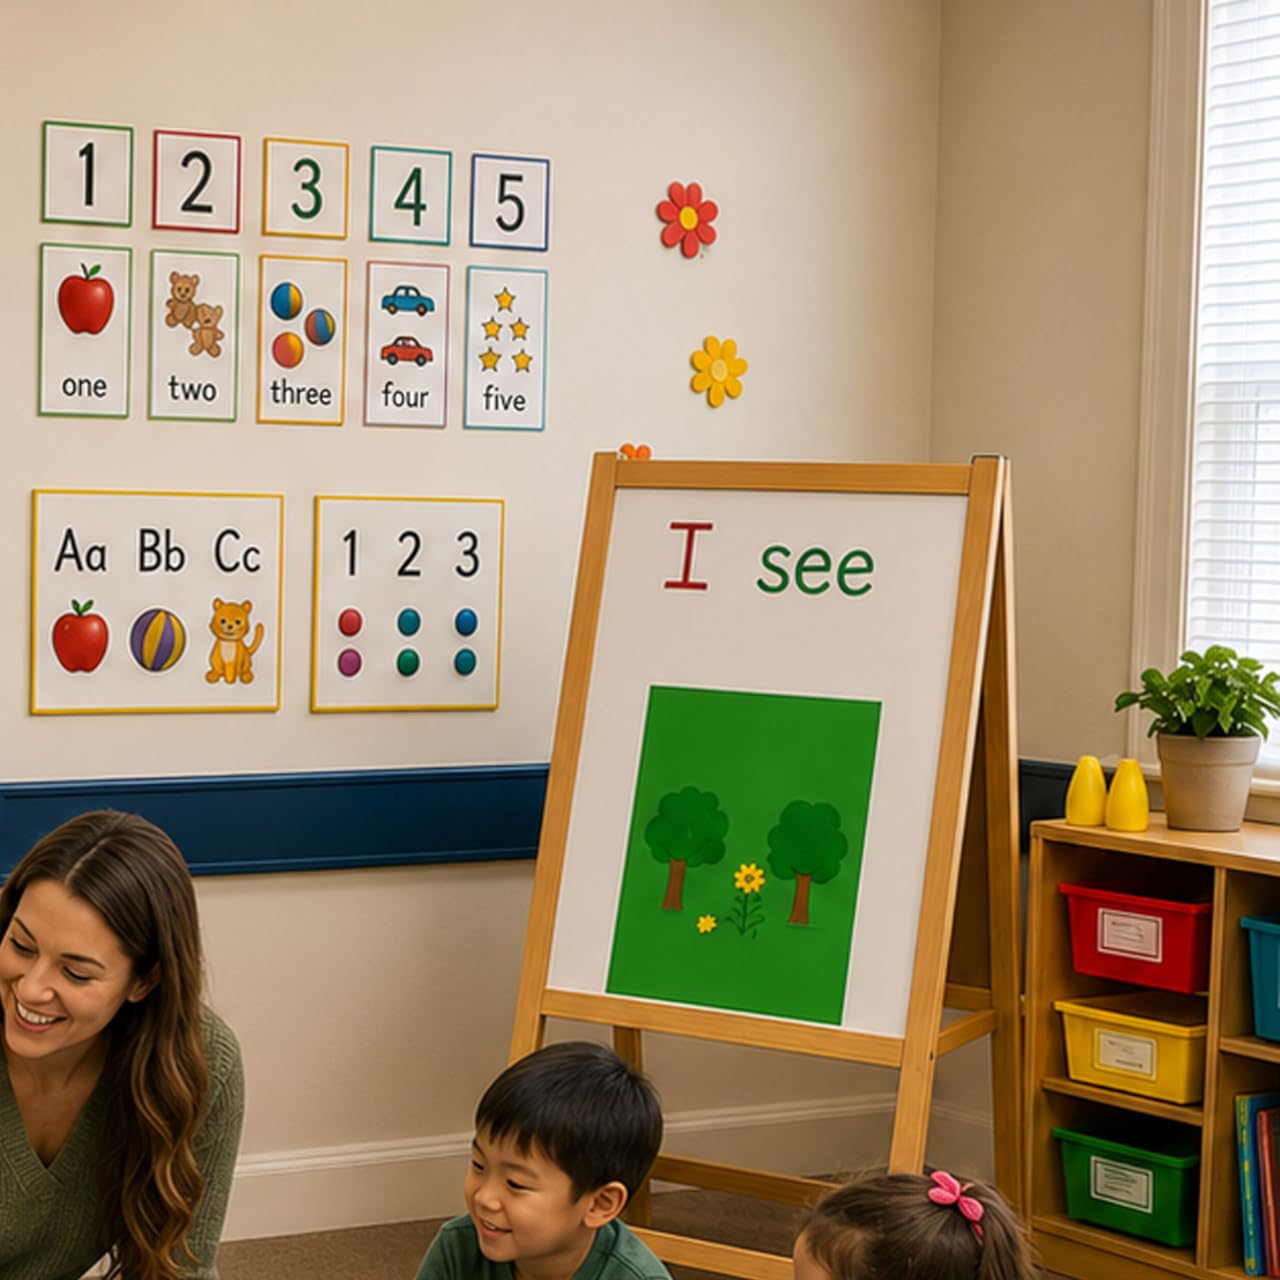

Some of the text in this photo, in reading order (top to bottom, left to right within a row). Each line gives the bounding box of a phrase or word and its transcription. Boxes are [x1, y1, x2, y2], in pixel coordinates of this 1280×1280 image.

[80, 143, 523, 231] 1 2 3 4 5
[62, 376, 107, 399] one
[170, 376, 216, 401] two
[271, 379, 331, 405] three
[383, 382, 428, 407] four
[485, 385, 525, 411] five
[55, 528, 260, 572] Aa Bb Cc
[344, 530, 478, 577] 1 2 3
[665, 523, 873, 596] I see
